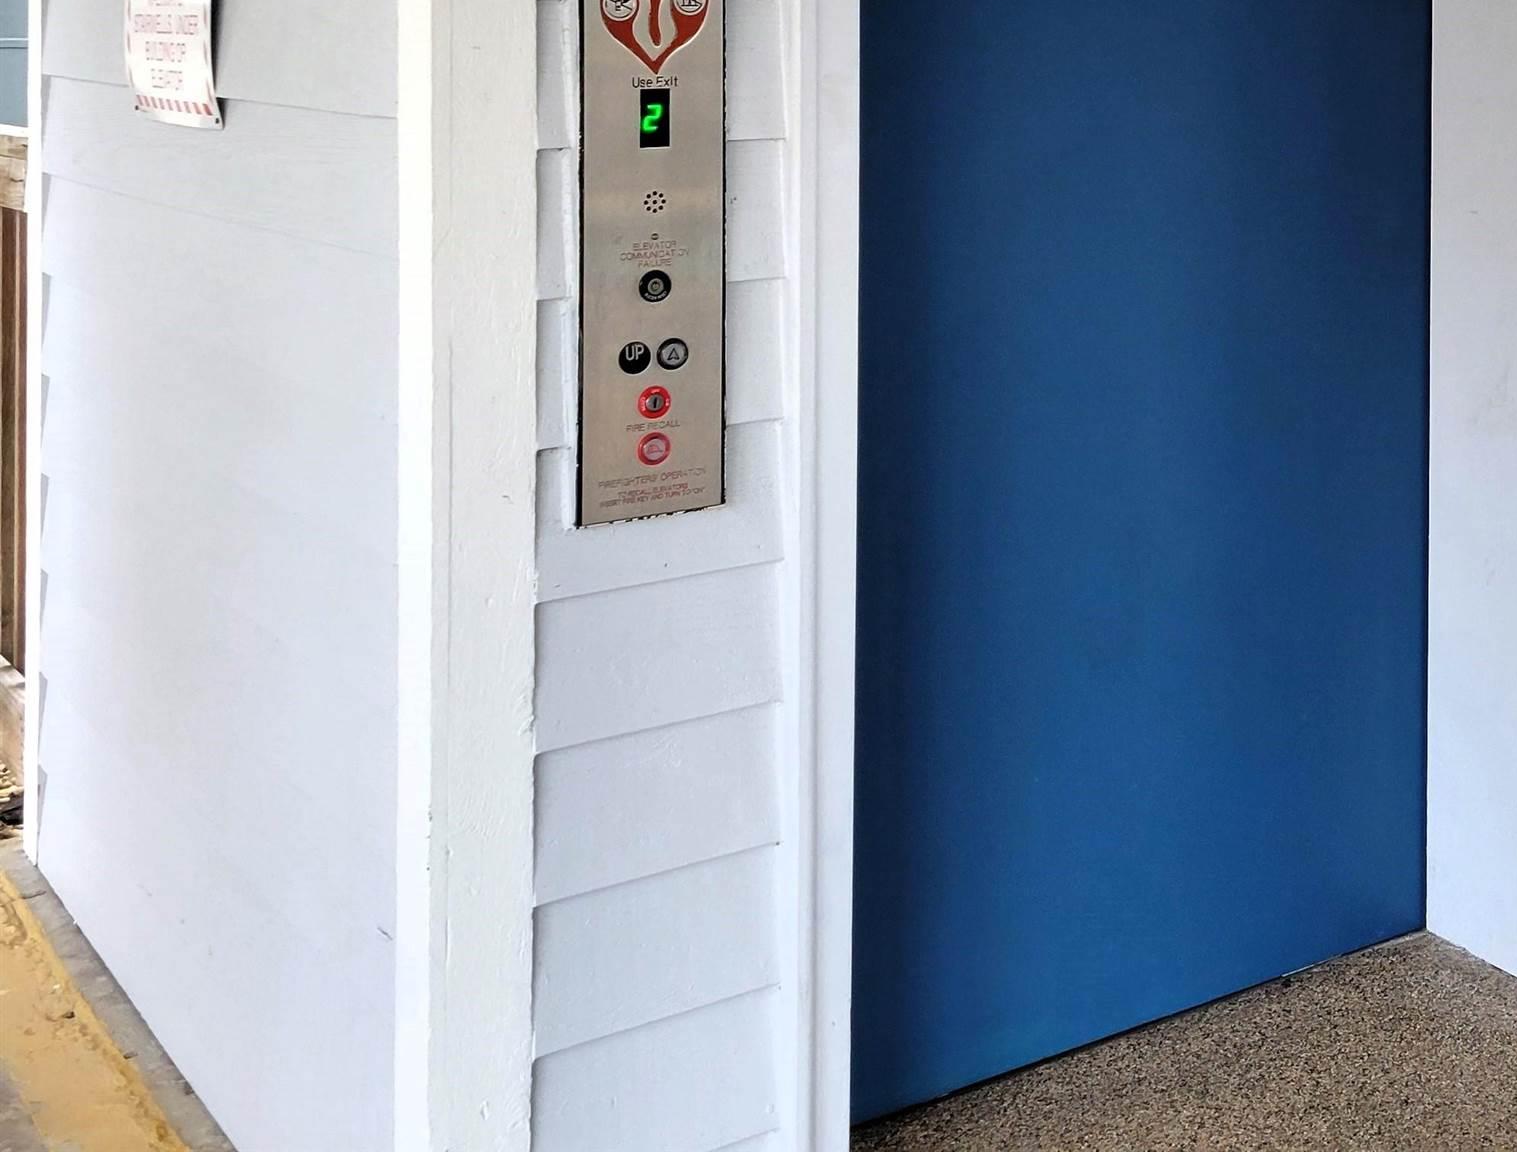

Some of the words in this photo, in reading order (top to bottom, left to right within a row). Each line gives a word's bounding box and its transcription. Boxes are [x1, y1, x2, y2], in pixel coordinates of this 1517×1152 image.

[632, 76, 653, 88] Use
[655, 76, 678, 88] Exit
[643, 103, 663, 132] 2
[625, 344, 645, 361] UP
